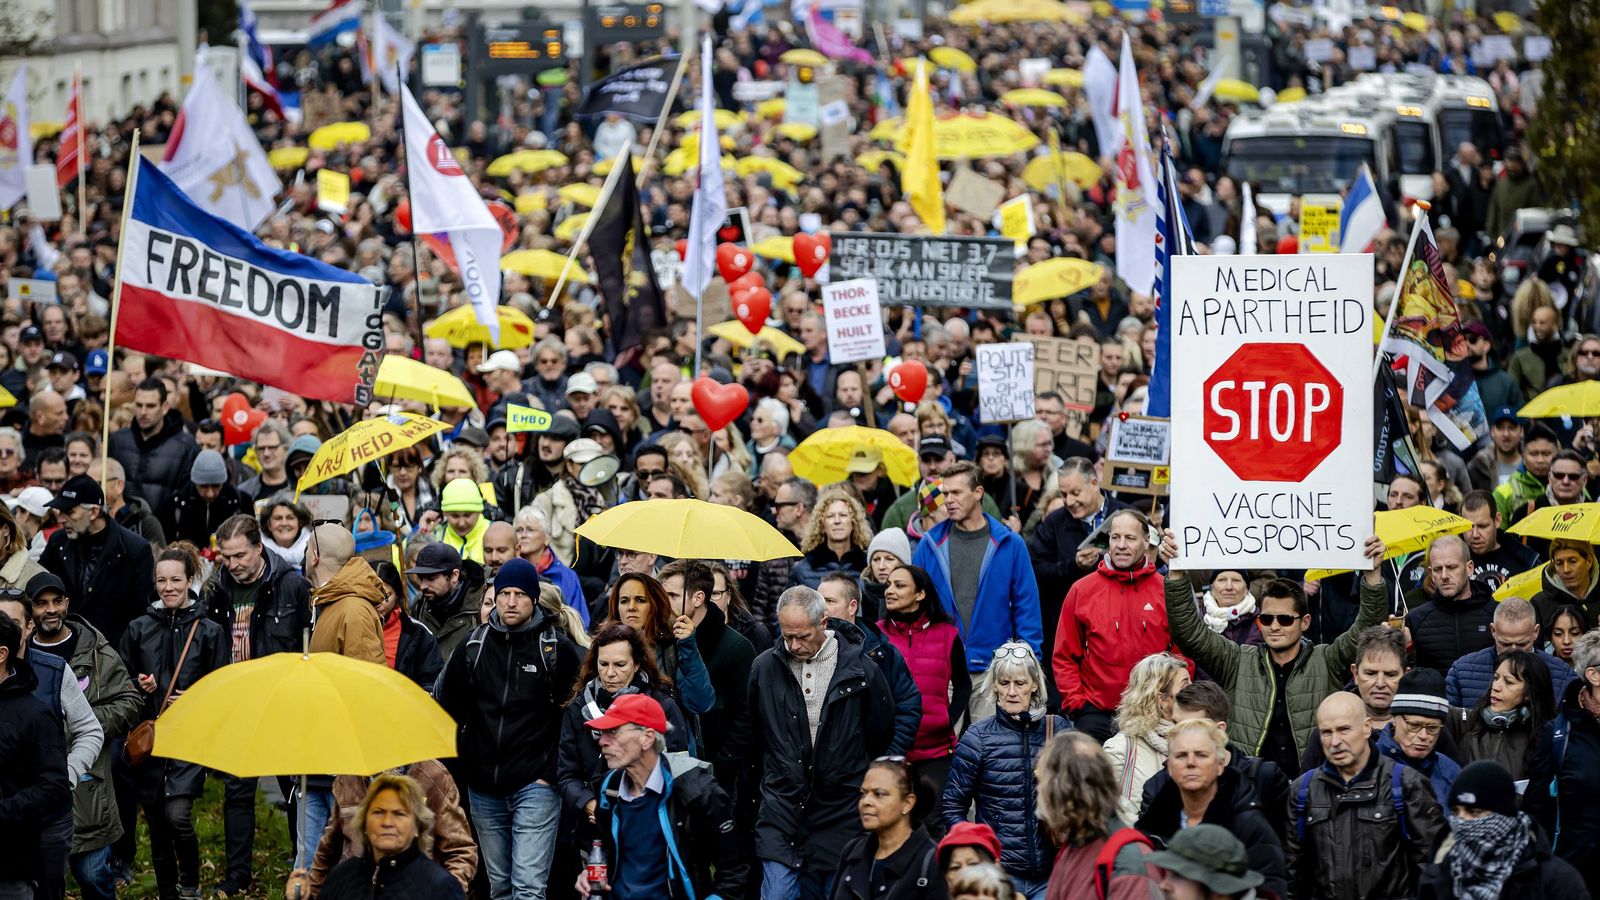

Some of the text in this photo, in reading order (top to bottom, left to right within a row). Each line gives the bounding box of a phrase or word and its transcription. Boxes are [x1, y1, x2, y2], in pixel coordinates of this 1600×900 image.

[147, 230, 341, 338] FREEDOM
[899, 261, 935, 280] AAN
[1215, 266, 1338, 293] MEDICAL
[830, 287, 869, 300] THOR-
[834, 304, 872, 319] BECKE
[1179, 298, 1365, 336] APARTHEID
[837, 324, 873, 338] HUILT
[512, 413, 547, 425] EHBO
[1210, 380, 1331, 443] STOP
[1213, 491, 1333, 520] VACCINE
[1184, 524, 1355, 557] PASSPORTS
